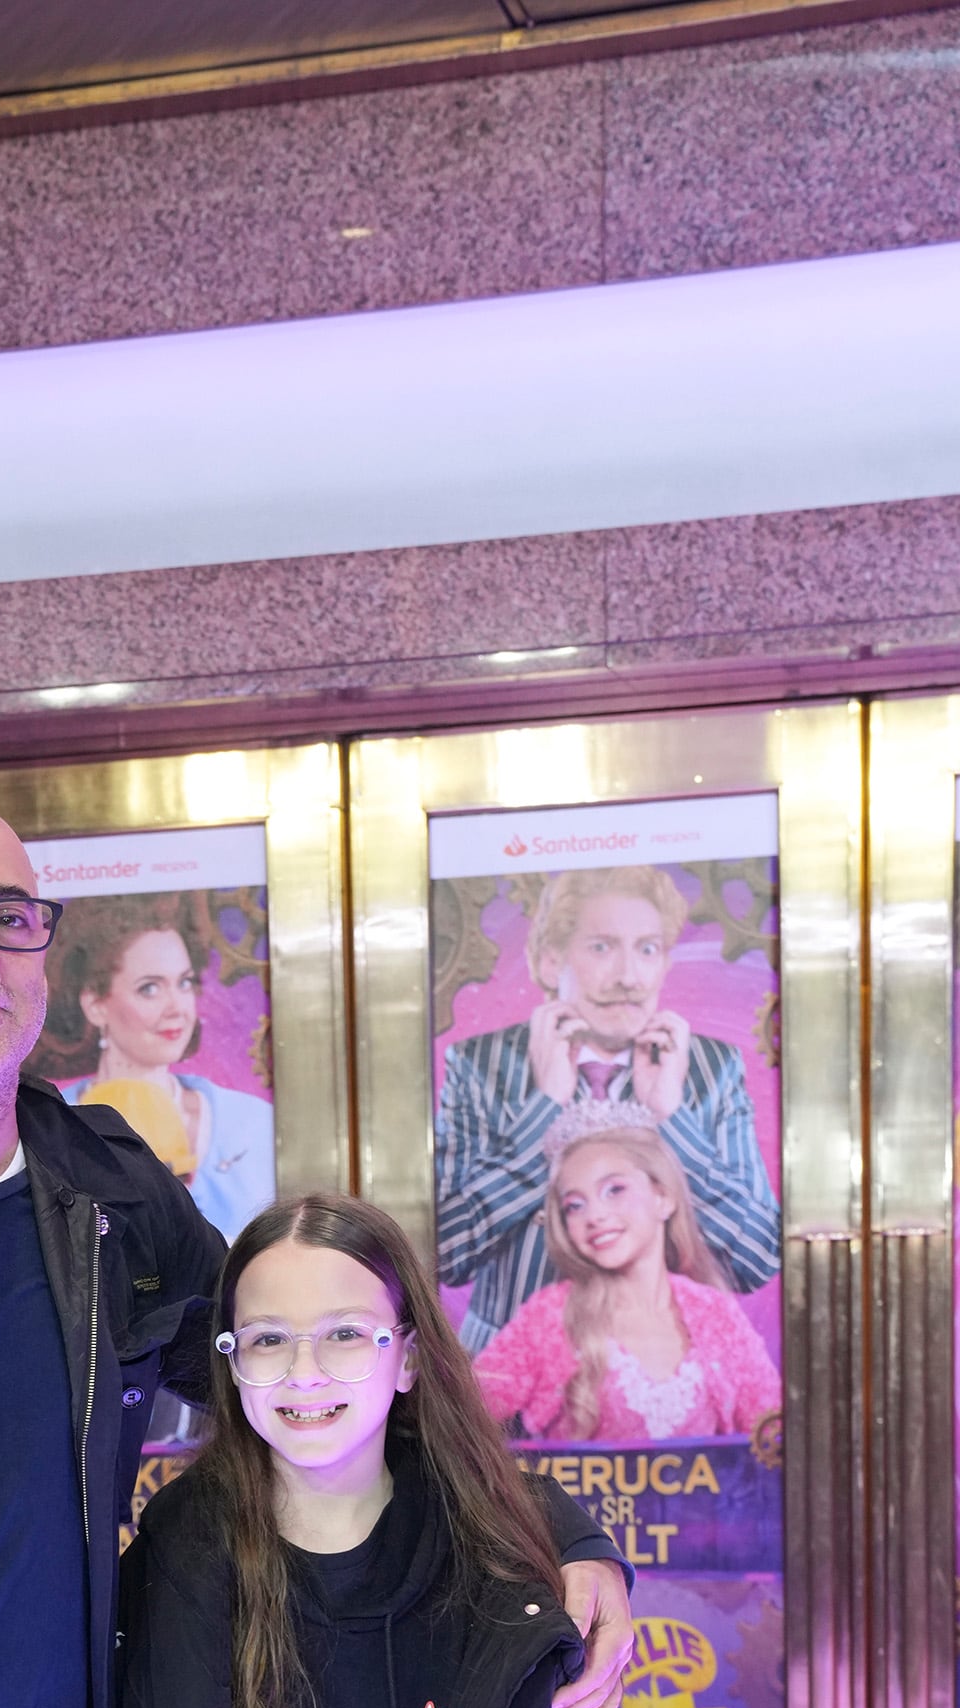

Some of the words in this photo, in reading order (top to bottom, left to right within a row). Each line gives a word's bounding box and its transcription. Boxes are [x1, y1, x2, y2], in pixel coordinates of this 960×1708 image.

[530, 831, 639, 856] Santander
[43, 860, 141, 883] Santander
[600, 1495, 642, 1526] SR.
